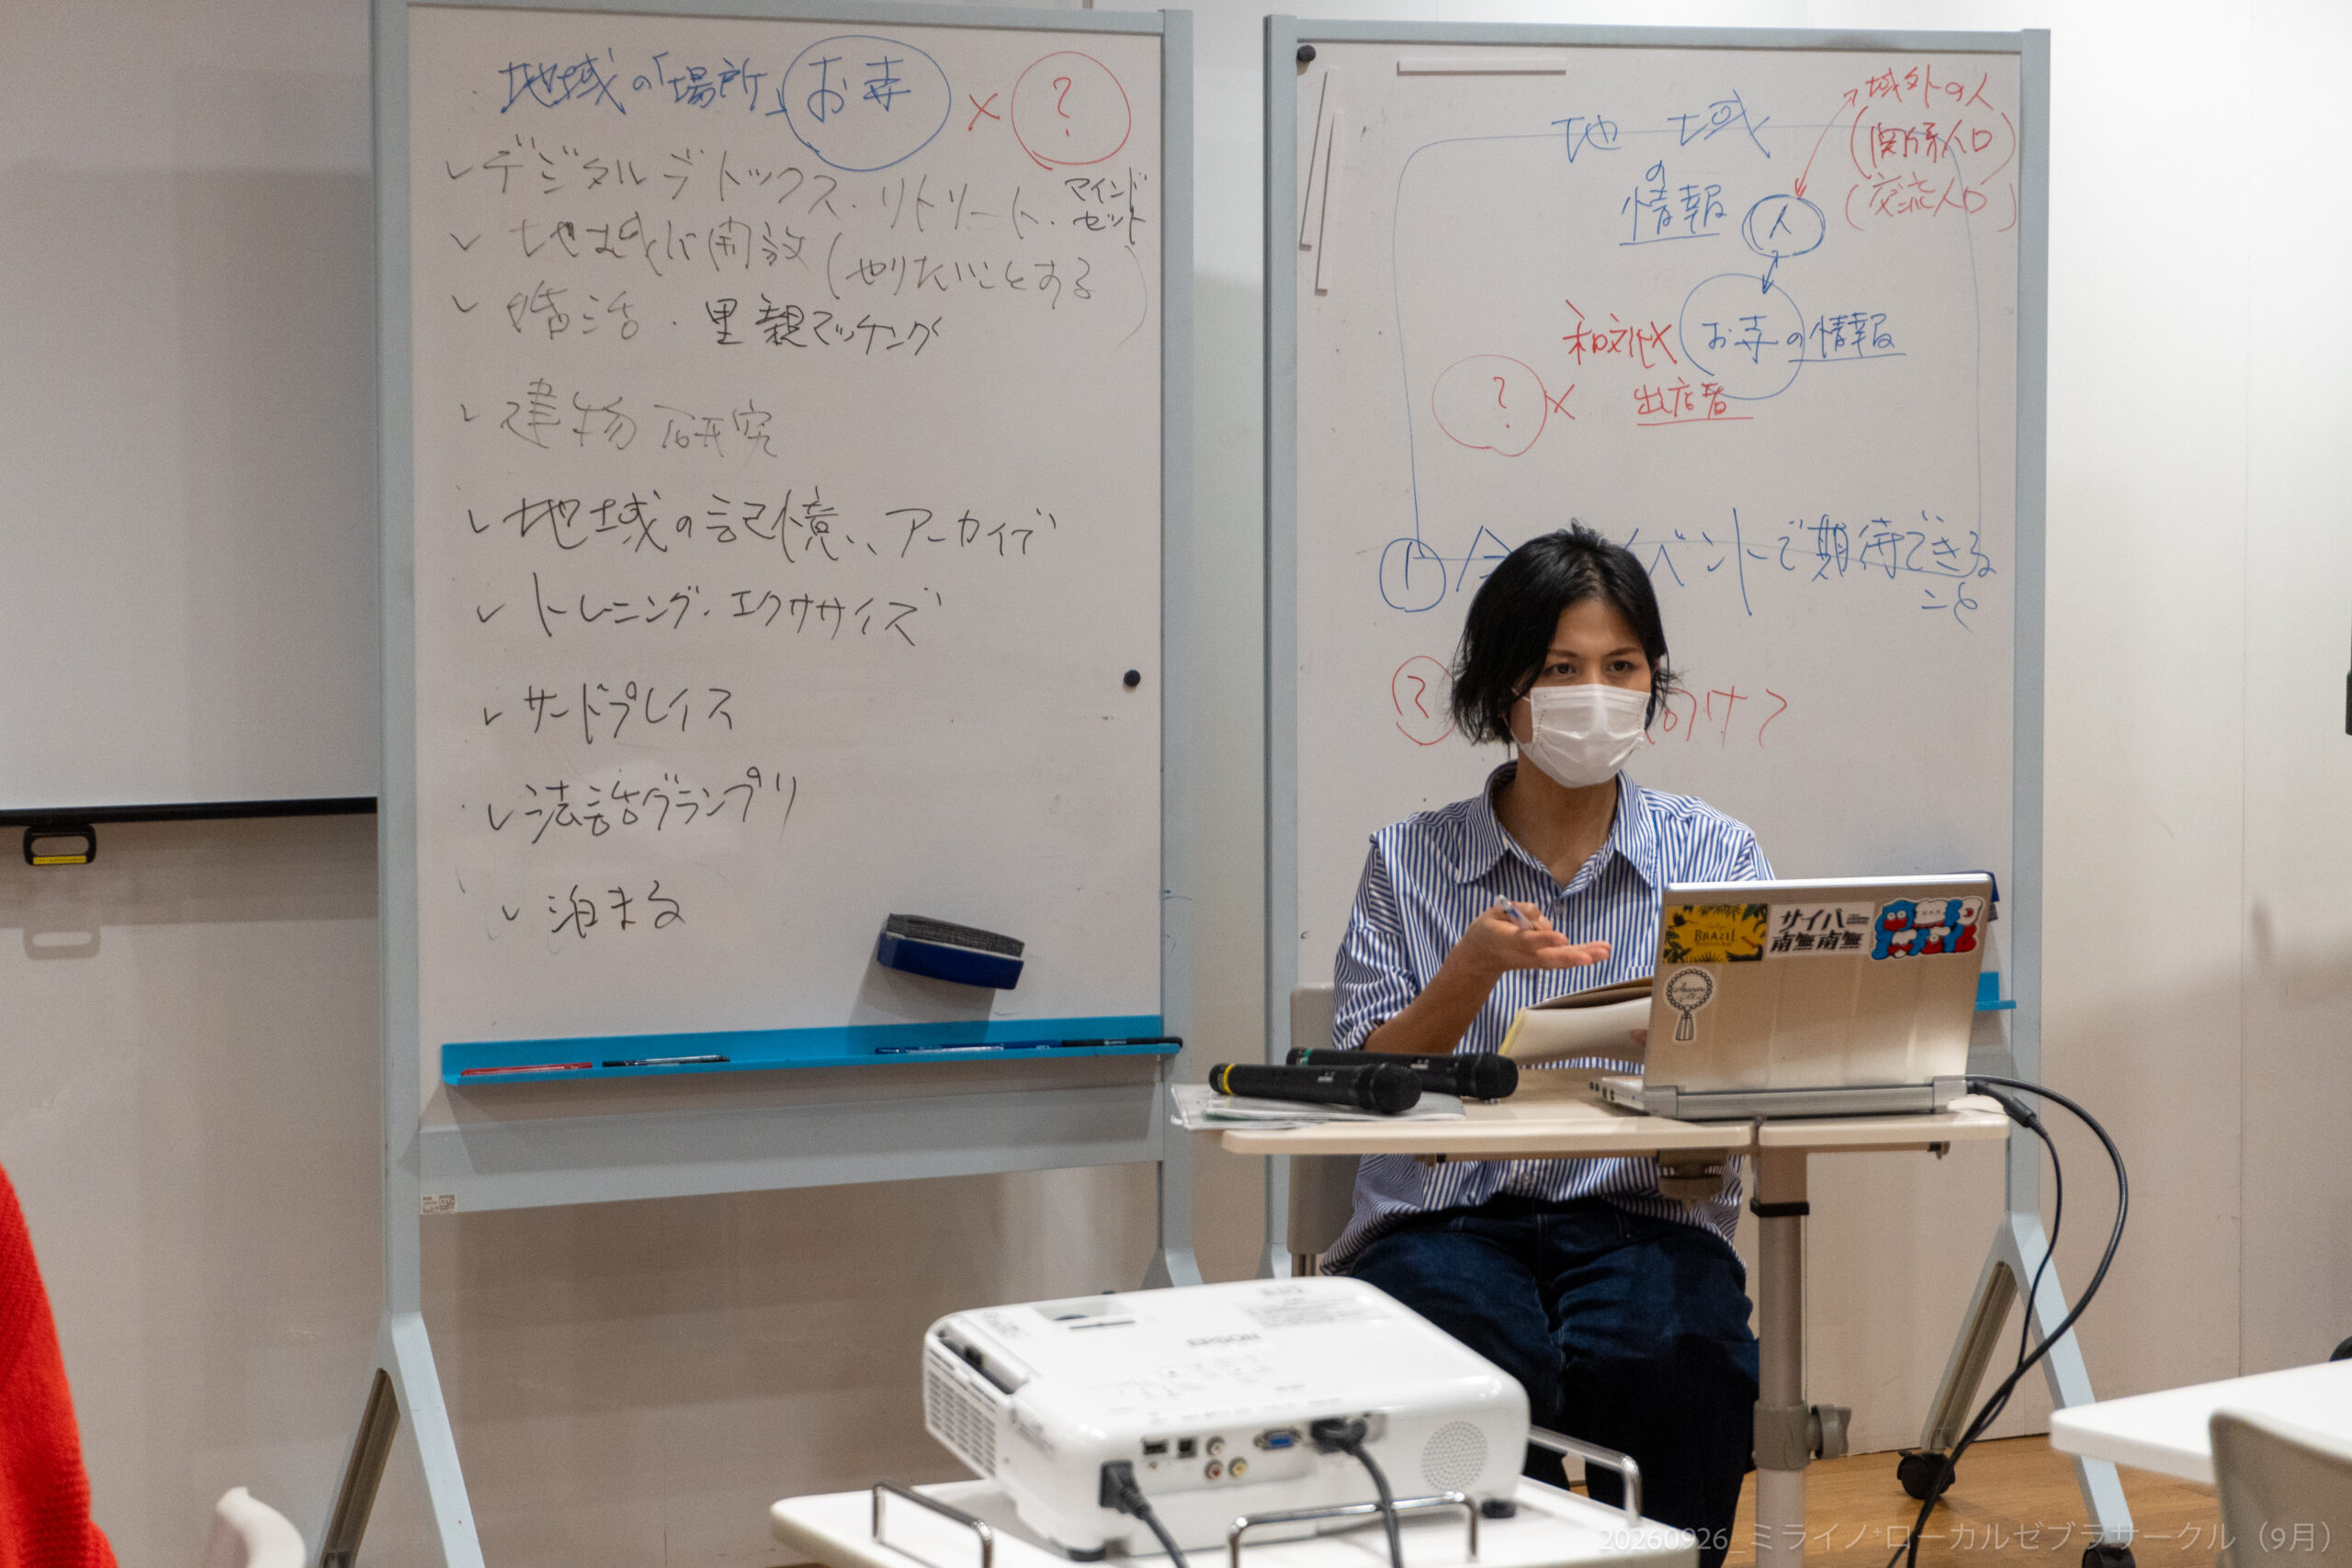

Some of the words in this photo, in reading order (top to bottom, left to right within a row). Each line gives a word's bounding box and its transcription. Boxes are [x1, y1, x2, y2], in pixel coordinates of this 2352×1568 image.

[808, 56, 911, 123] お寺
[1864, 63, 1995, 111] 域外の人
[1621, 183, 1727, 243] 情報
[523, 680, 733, 745] サードプレイス
[548, 879, 686, 939] 泊まる
[1694, 928, 1736, 942] BRAZIL
[1779, 908, 1871, 933] サイバー
[1770, 930, 1865, 953] 南無南無
